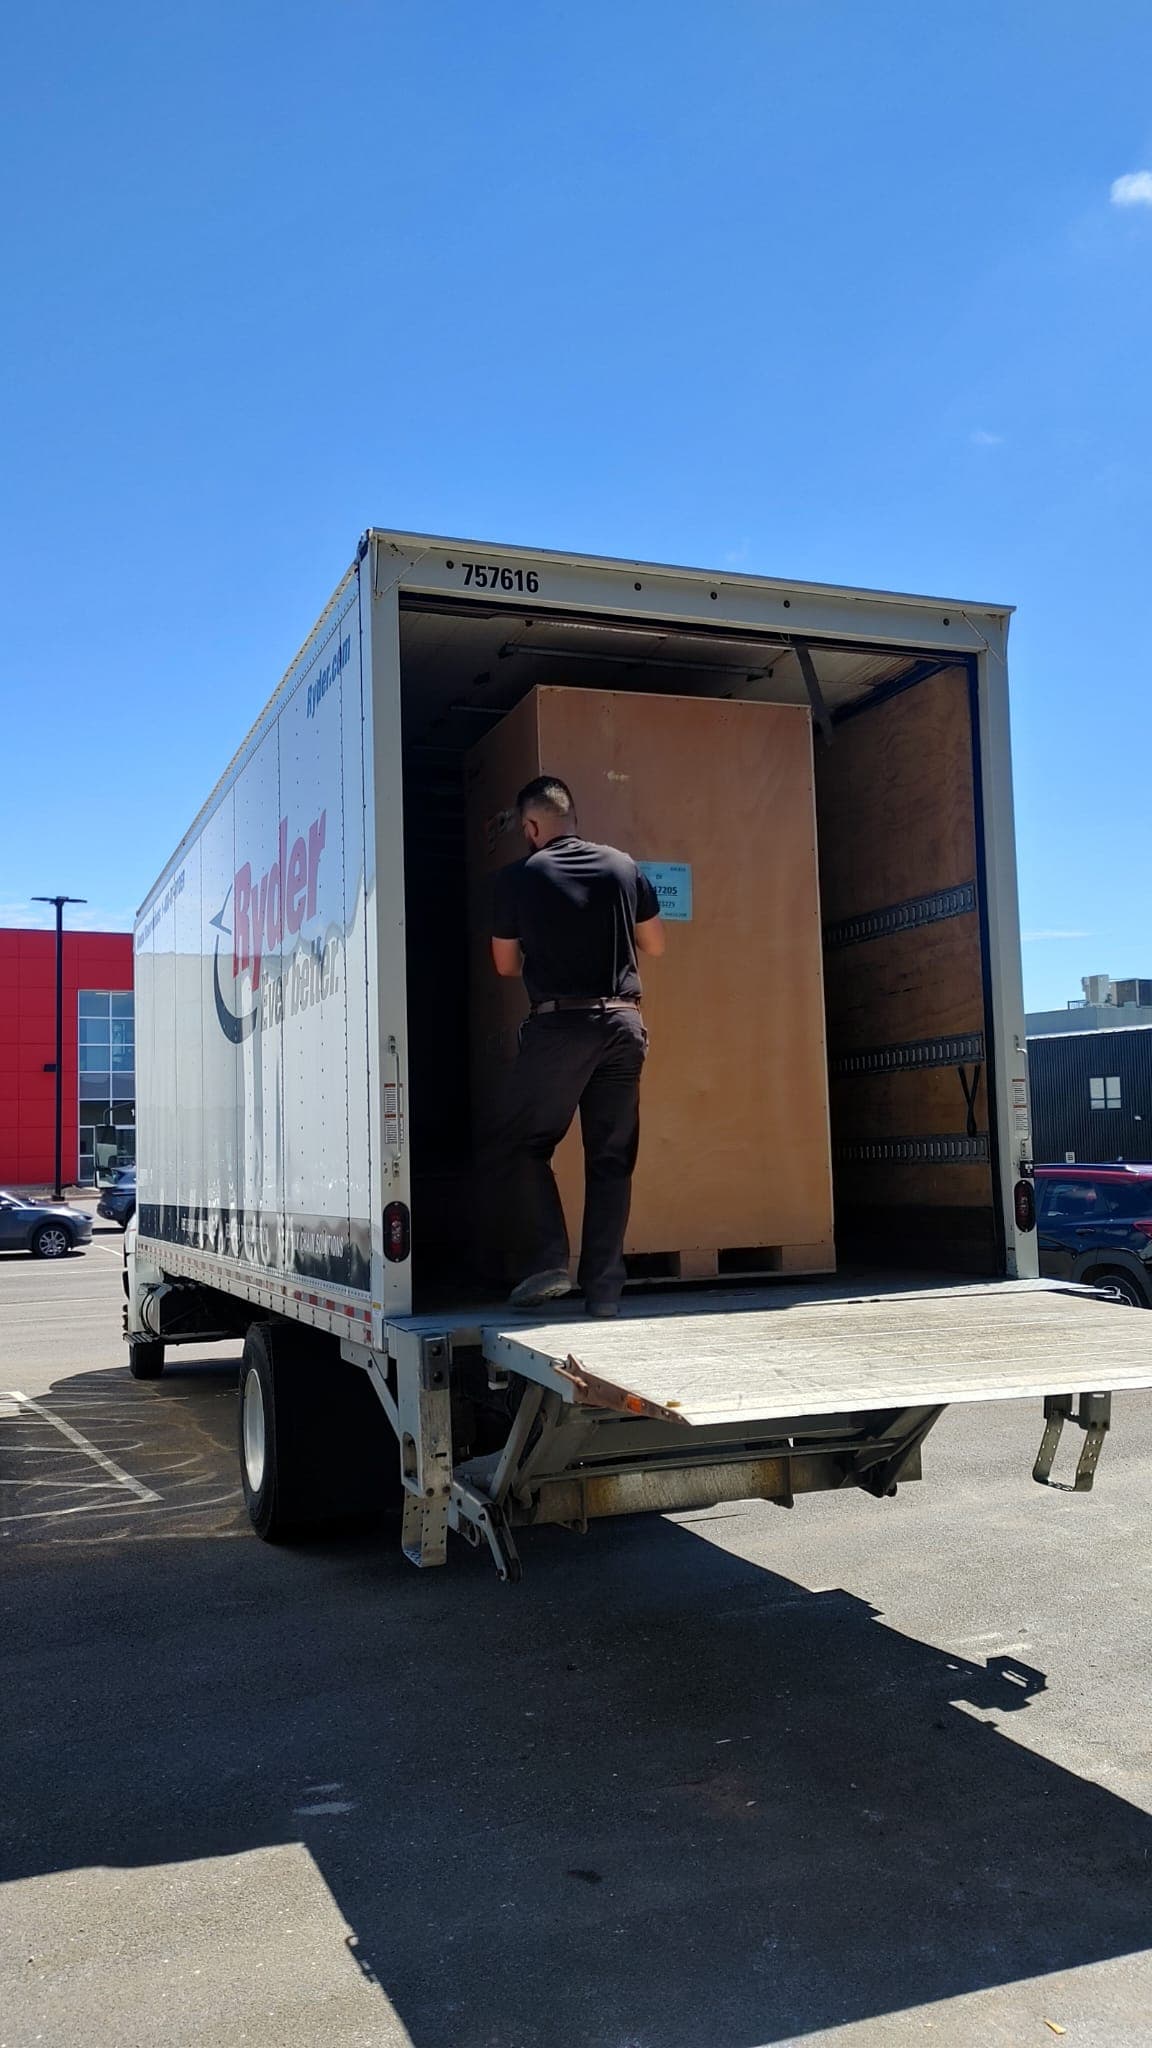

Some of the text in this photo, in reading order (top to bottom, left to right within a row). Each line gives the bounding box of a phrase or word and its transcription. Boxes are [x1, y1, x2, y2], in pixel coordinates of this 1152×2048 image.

[462, 563, 539, 593] 757616
[306, 633, 350, 719] Ryder.com
[232, 808, 327, 993] Ryder
[261, 971, 289, 1033] Ever
